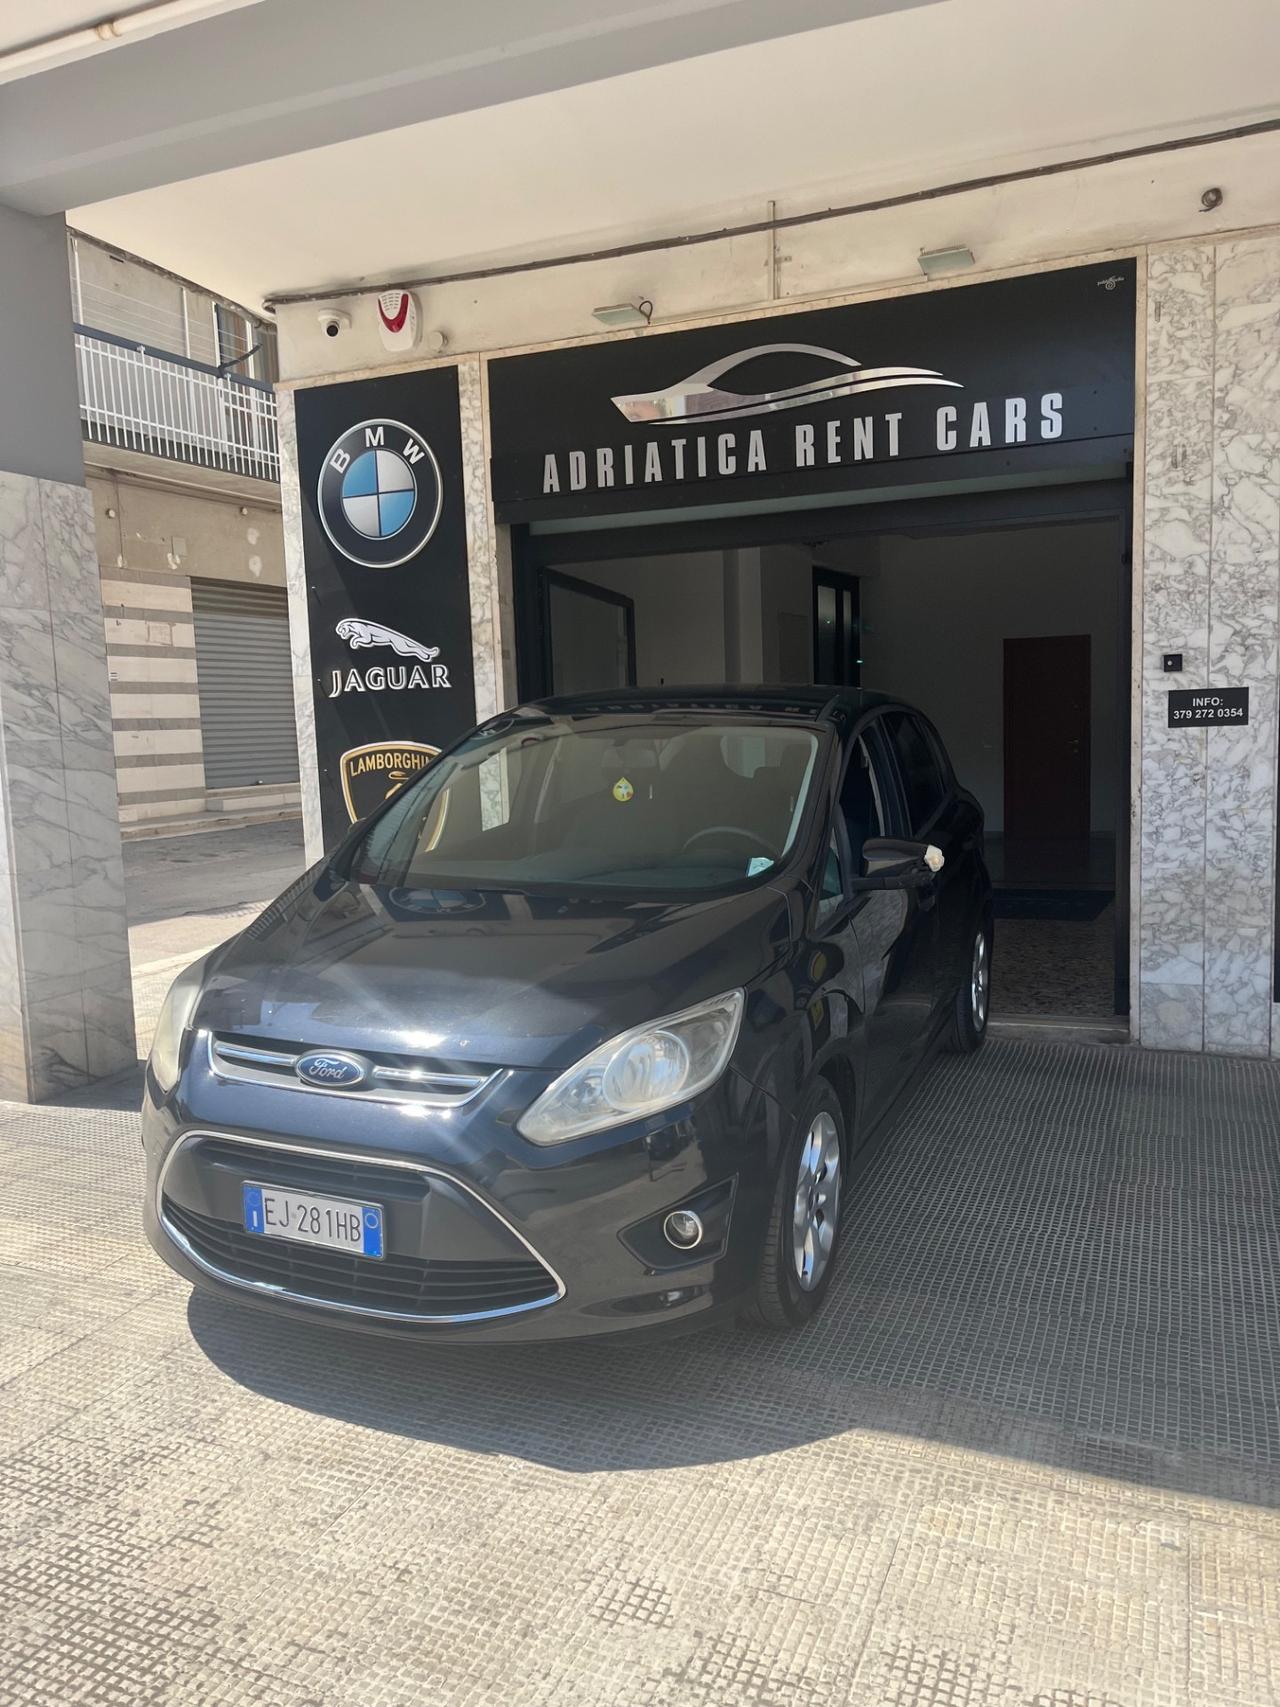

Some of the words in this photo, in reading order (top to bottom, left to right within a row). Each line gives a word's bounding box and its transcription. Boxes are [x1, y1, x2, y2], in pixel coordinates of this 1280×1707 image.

[329, 426, 425, 474] BMW
[542, 429, 767, 494] ADRIATICA
[795, 412, 903, 468] RENT
[936, 392, 1063, 452] CARS
[328, 664, 452, 698] JAGUAR
[1173, 710, 1193, 719] 379
[1195, 709, 1215, 718] 272
[1217, 708, 1244, 718] 0354
[1192, 697, 1224, 707] INFO:
[350, 752, 431, 776] LAMBORGHI
[308, 1058, 348, 1080] Ford
